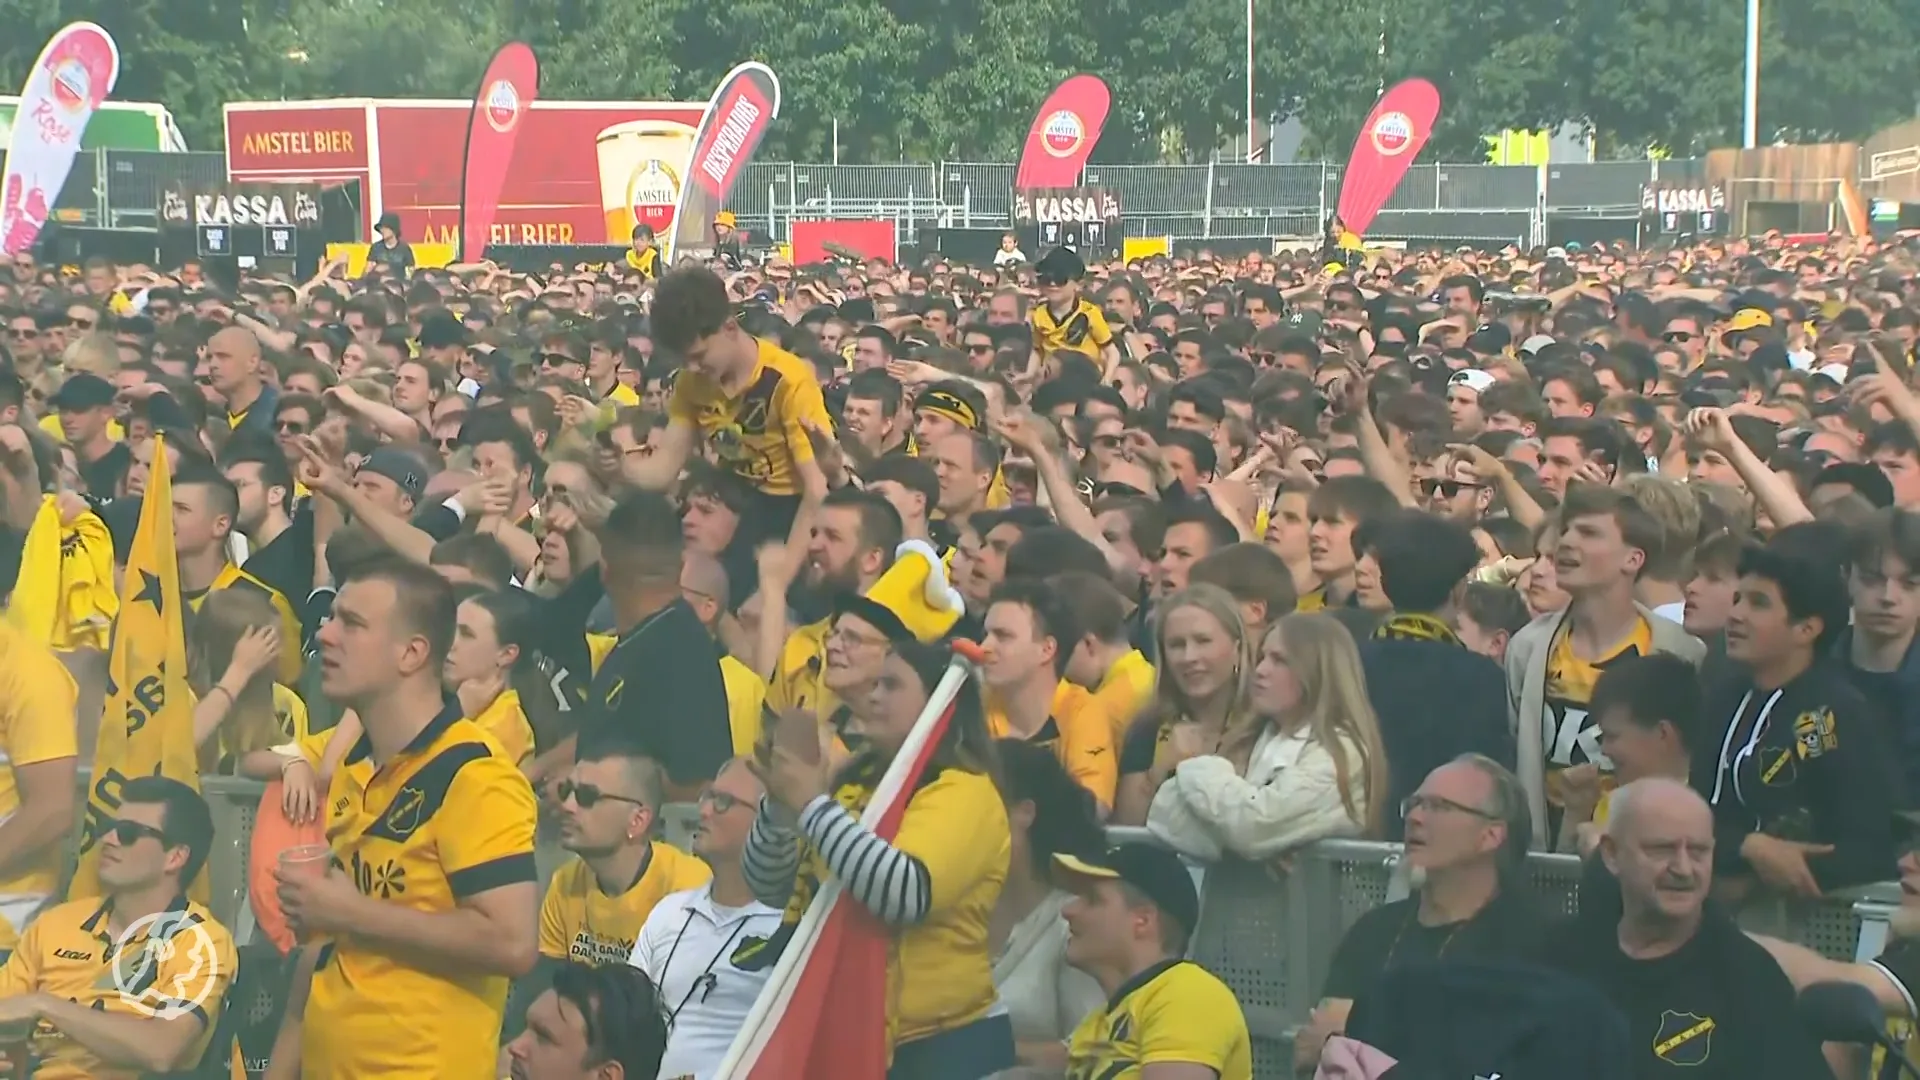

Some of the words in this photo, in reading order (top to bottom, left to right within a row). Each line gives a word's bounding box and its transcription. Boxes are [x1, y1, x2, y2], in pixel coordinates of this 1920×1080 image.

[243, 131, 312, 155] AMSTEL
[313, 130, 354, 153] BIER
[702, 94, 760, 184] DESPERADOS
[636, 189, 673, 203] AMSTEL
[1658, 188, 1709, 213] KASSA
[195, 194, 289, 225] KASSA
[646, 207, 664, 218] BIER
[1035, 197, 1099, 223] KASSA
[521, 222, 575, 246] BIER
